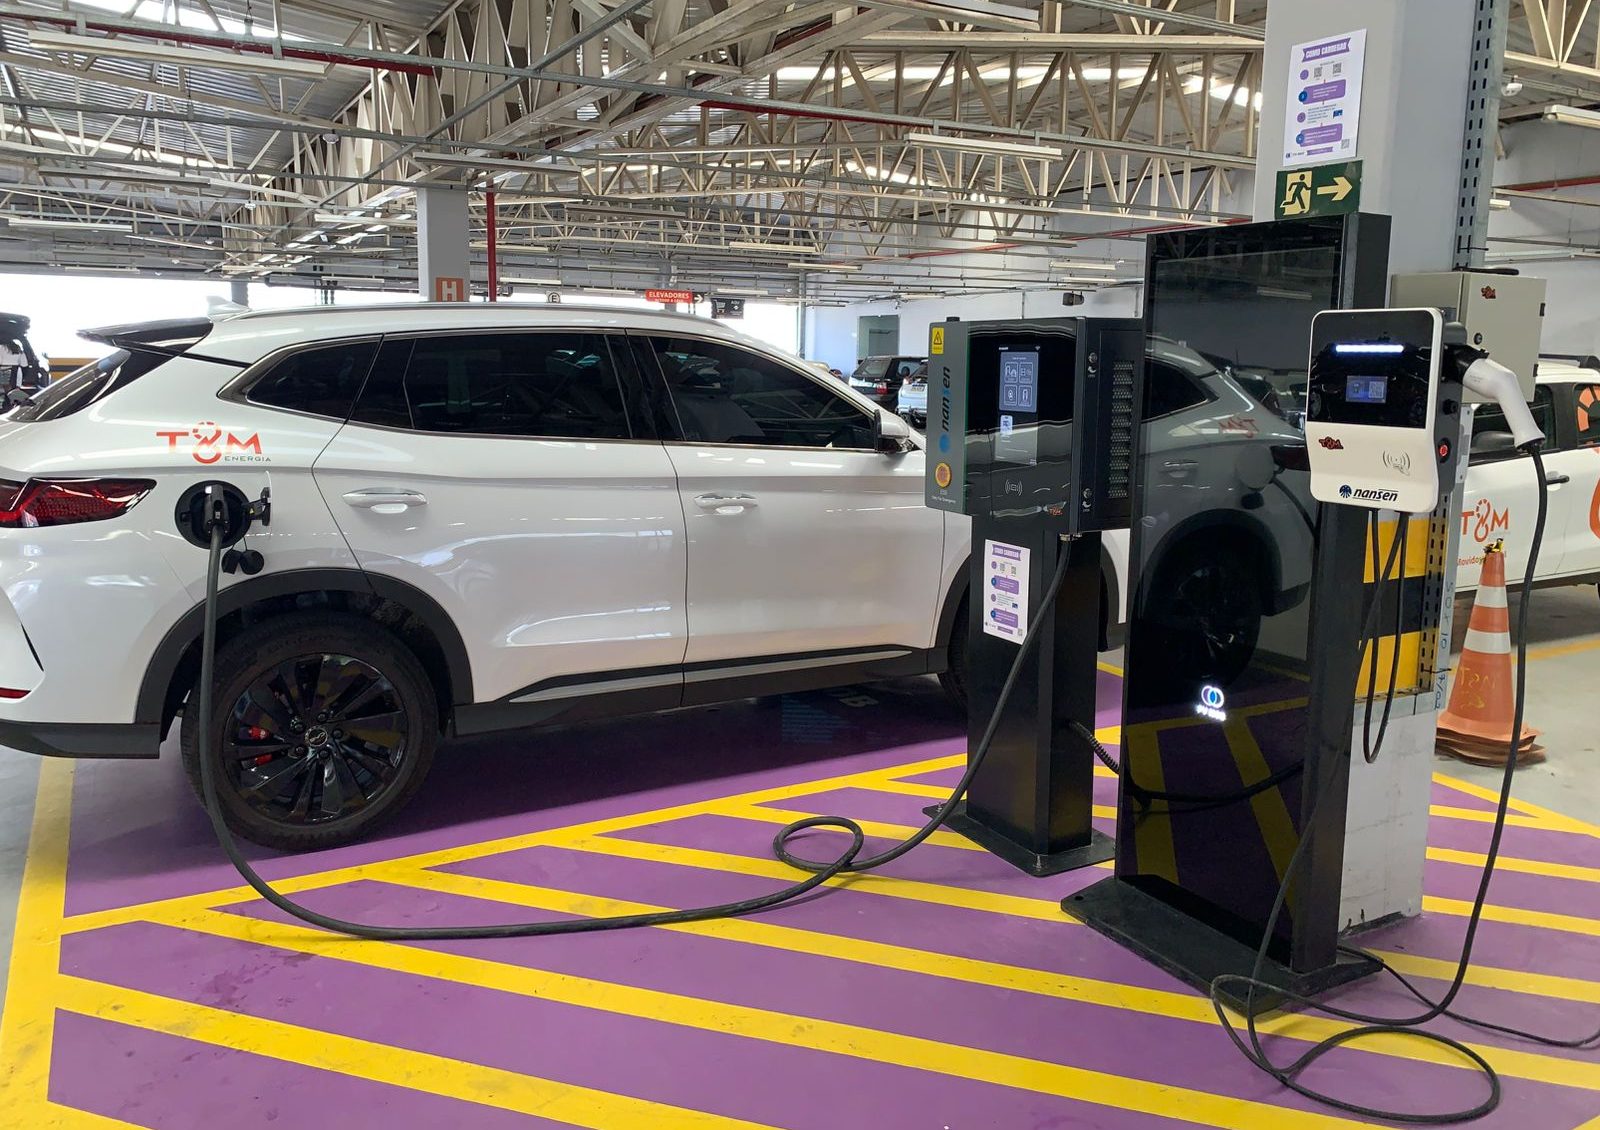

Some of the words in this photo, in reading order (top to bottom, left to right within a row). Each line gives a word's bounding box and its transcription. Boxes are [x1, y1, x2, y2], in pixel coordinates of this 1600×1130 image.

[442, 281, 457, 302] H
[649, 291, 690, 299] ELEVADORES
[1353, 488, 1398, 502] nansen
